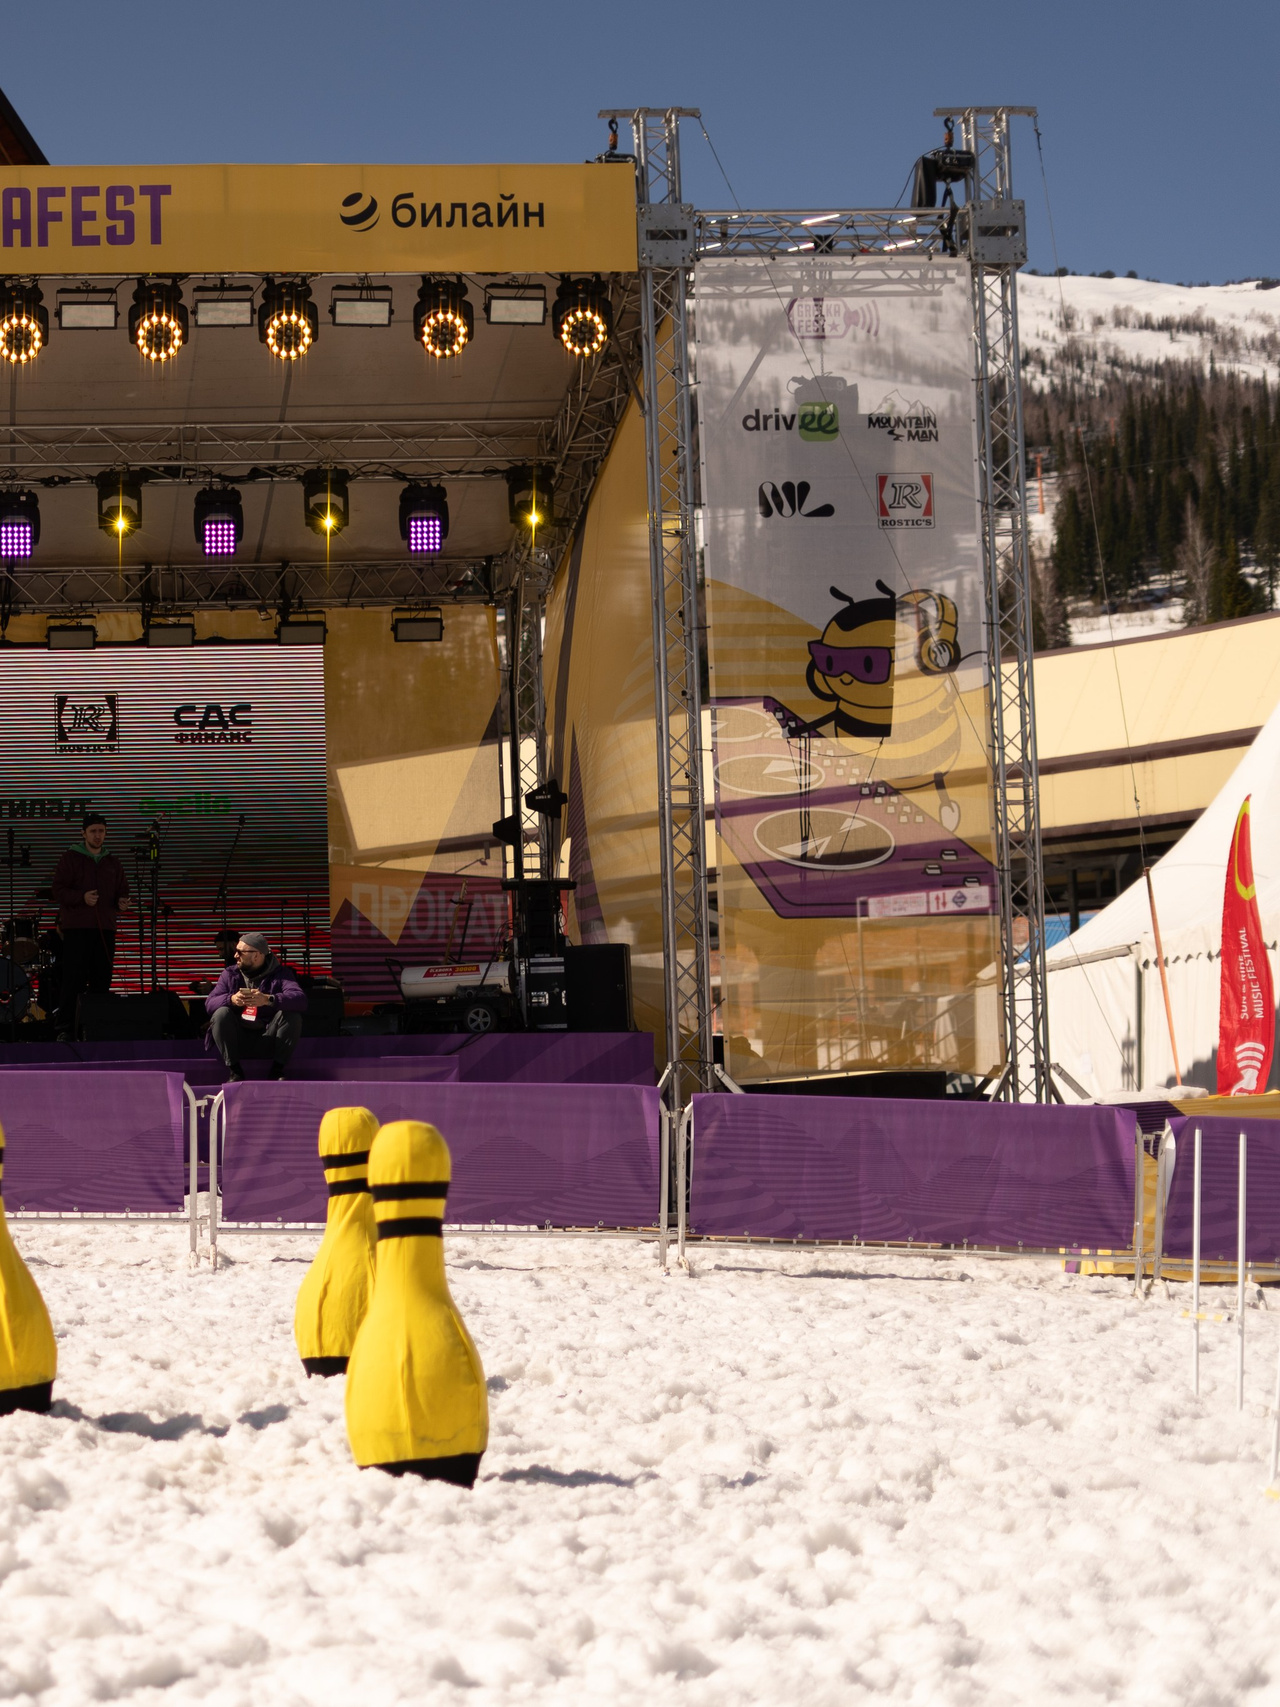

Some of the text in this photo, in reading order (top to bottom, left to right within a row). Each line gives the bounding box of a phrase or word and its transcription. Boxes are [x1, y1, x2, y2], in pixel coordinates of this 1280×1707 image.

[391, 192, 545, 228] билайн
[742, 407, 840, 434] drivee
[867, 415, 938, 429] MOUNTAIN
[907, 429, 939, 442] MAN
[881, 518, 933, 527] ROSTIC'S
[351, 882, 507, 945] ПРОКАТ
[1238, 926, 1265, 1019] MUSIC FESTIVAL
